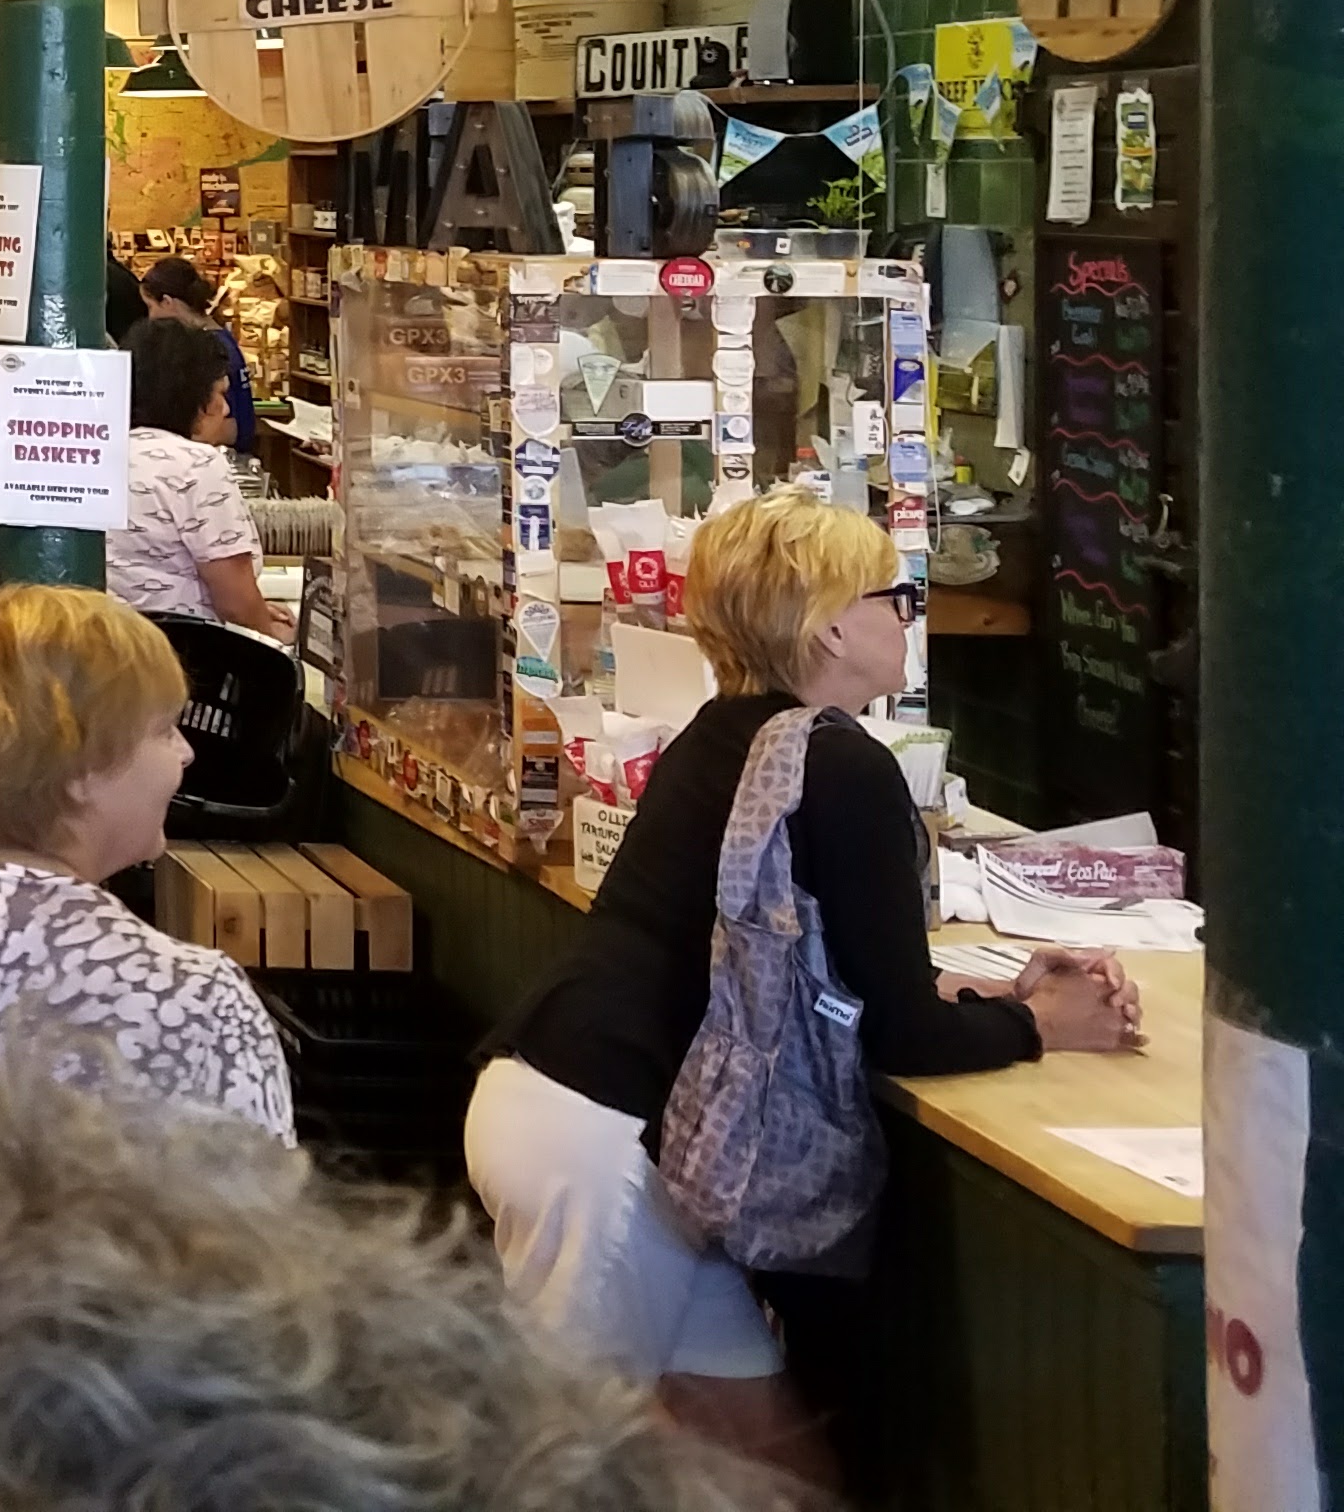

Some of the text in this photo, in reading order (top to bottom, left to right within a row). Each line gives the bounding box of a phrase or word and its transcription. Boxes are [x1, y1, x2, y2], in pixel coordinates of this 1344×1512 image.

[389, 328, 448, 345] GPX3
[407, 367, 466, 383] GPX3
[6, 419, 110, 441] SHOPPING
[14, 444, 101, 465] BASKETS
